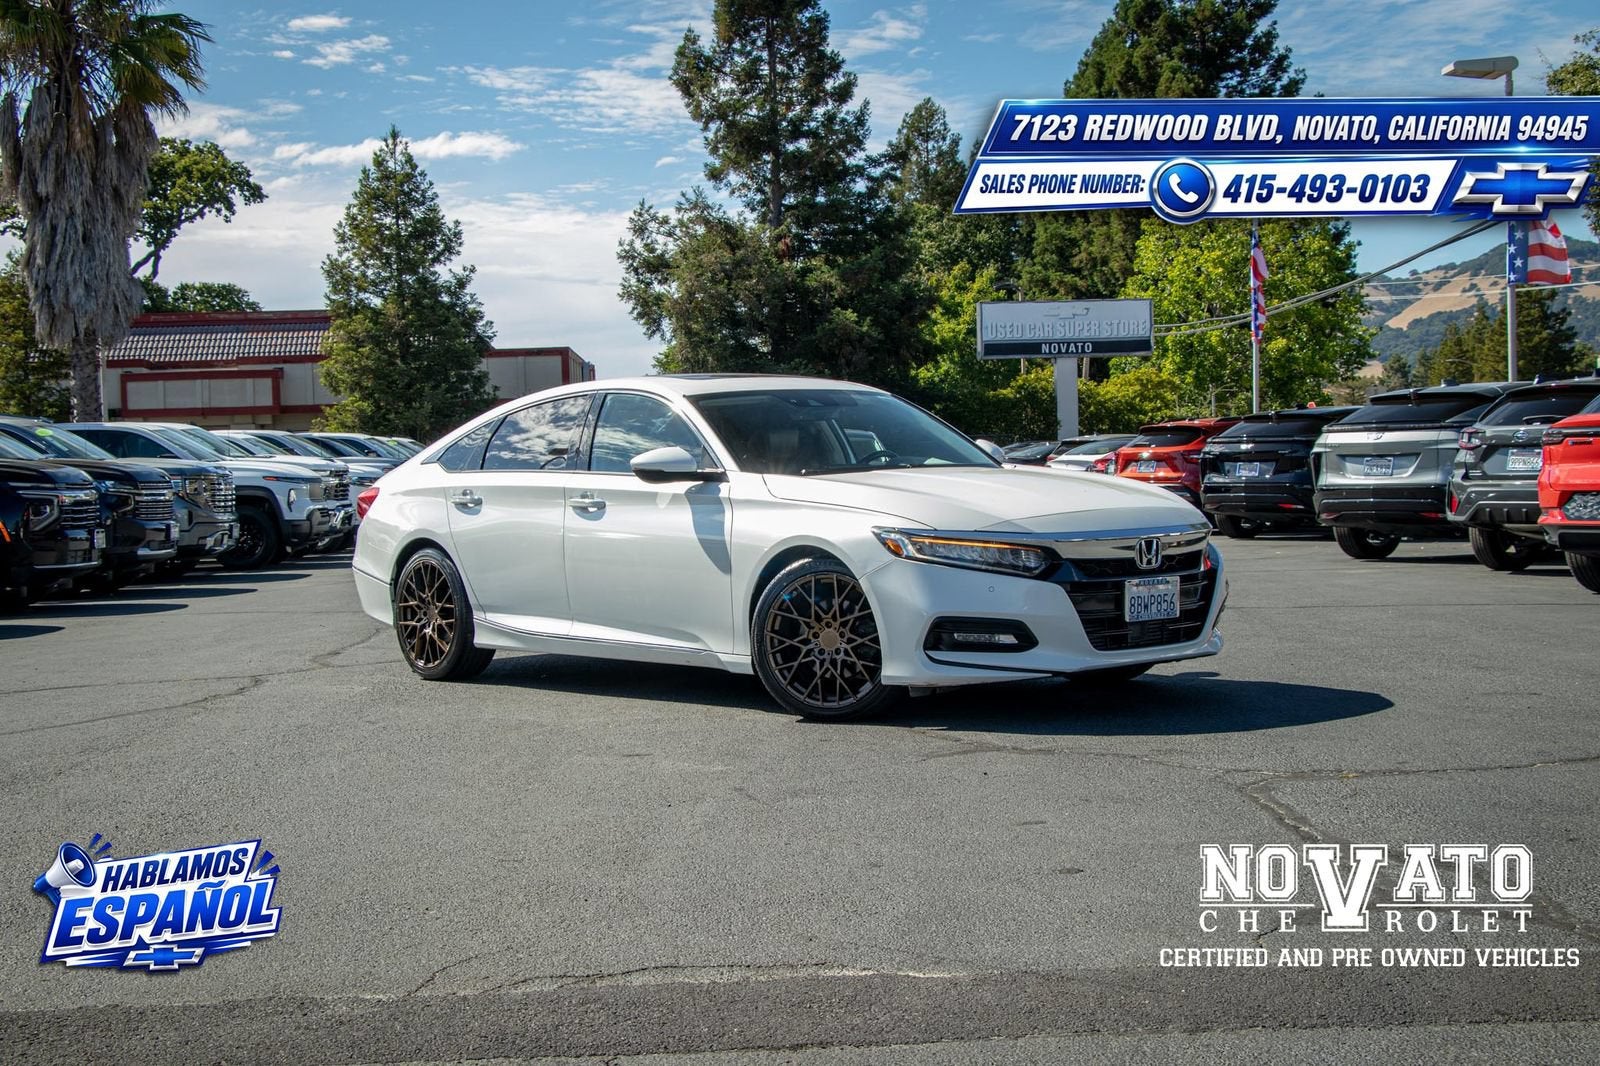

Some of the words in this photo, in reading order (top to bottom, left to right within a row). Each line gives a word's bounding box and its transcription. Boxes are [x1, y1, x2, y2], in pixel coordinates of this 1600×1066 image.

[988, 321, 1023, 339] USED
[1028, 320, 1053, 338] CAR
[1057, 320, 1099, 337] SUPER
[1105, 319, 1147, 336] STORE
[1041, 342, 1092, 354] NOVATO
[1129, 593, 1176, 614] 8BWP856
